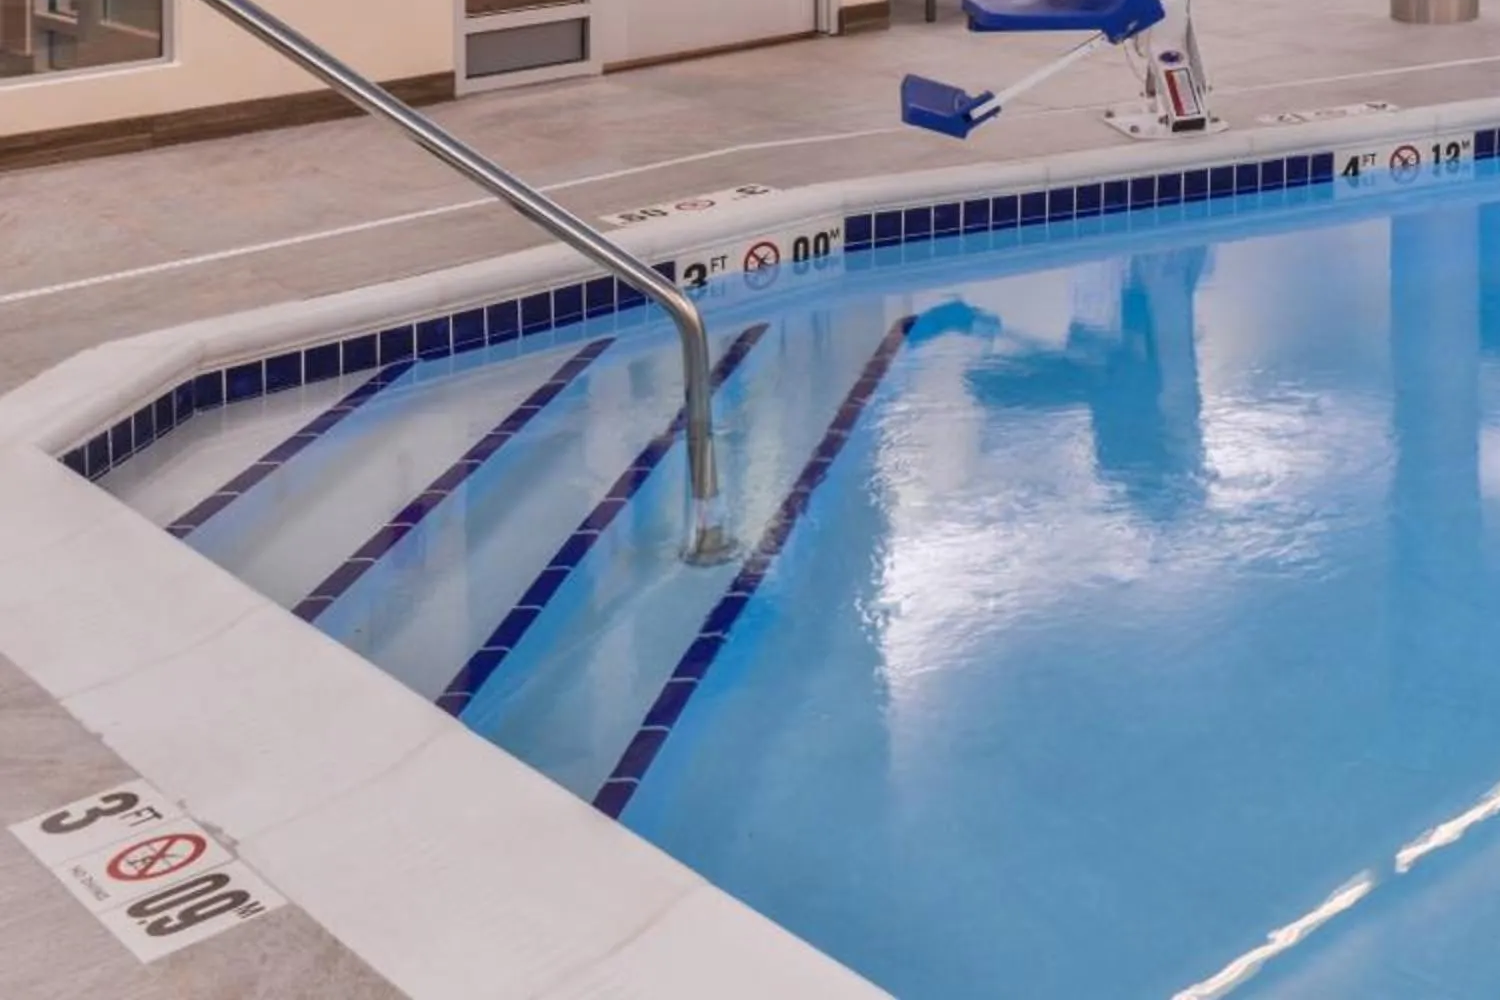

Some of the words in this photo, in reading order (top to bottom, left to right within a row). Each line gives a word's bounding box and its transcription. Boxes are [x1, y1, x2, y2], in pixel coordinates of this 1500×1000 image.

[710, 255, 728, 273] FT
[40, 791, 140, 835] 3
[118, 804, 163, 828] FT
[236, 900, 266, 919] M
